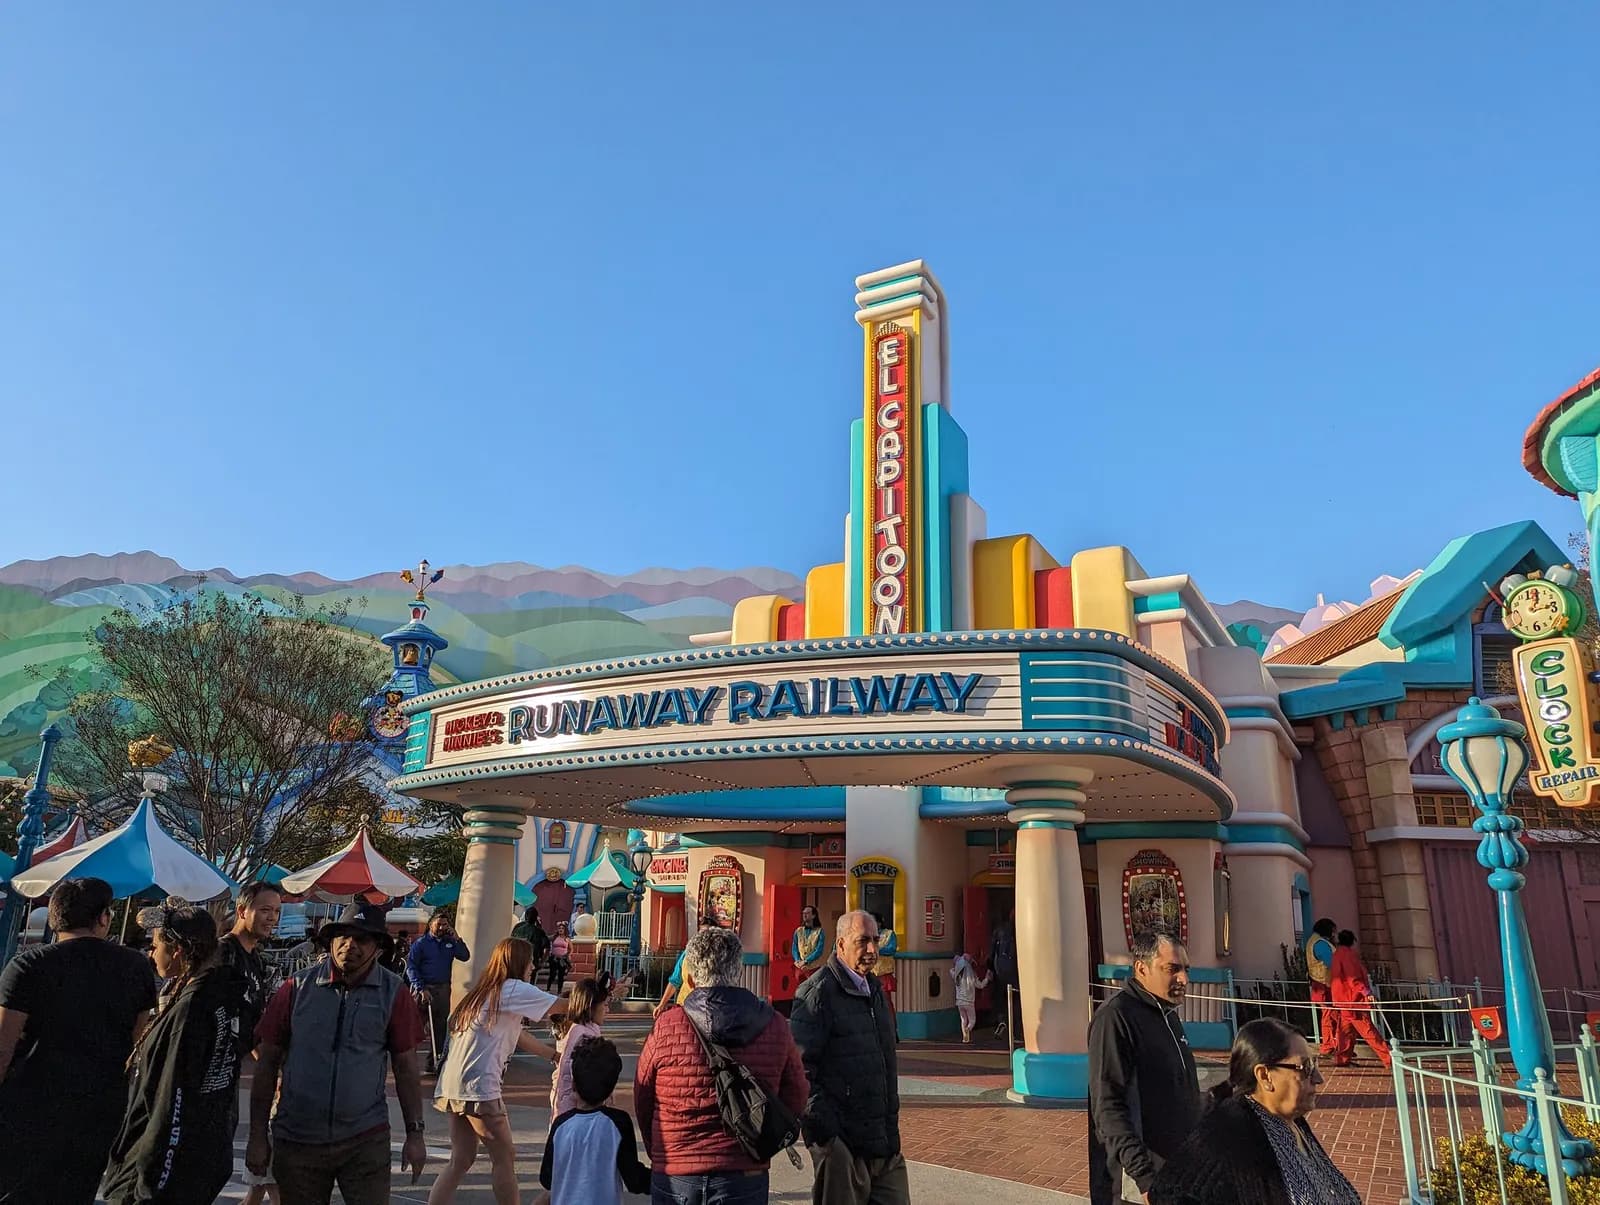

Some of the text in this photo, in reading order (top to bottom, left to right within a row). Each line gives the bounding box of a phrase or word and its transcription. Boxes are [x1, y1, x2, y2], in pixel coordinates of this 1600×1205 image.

[877, 337, 899, 395] EL
[871, 400, 907, 634] CAPITOON
[1533, 621, 1541, 631] 6
[508, 671, 982, 745] RUNAWAY RAILWAY
[1530, 650, 1577, 769] CLOCK
[1541, 765, 1599, 789] REPAIR
[851, 862, 898, 878] TICKETS
